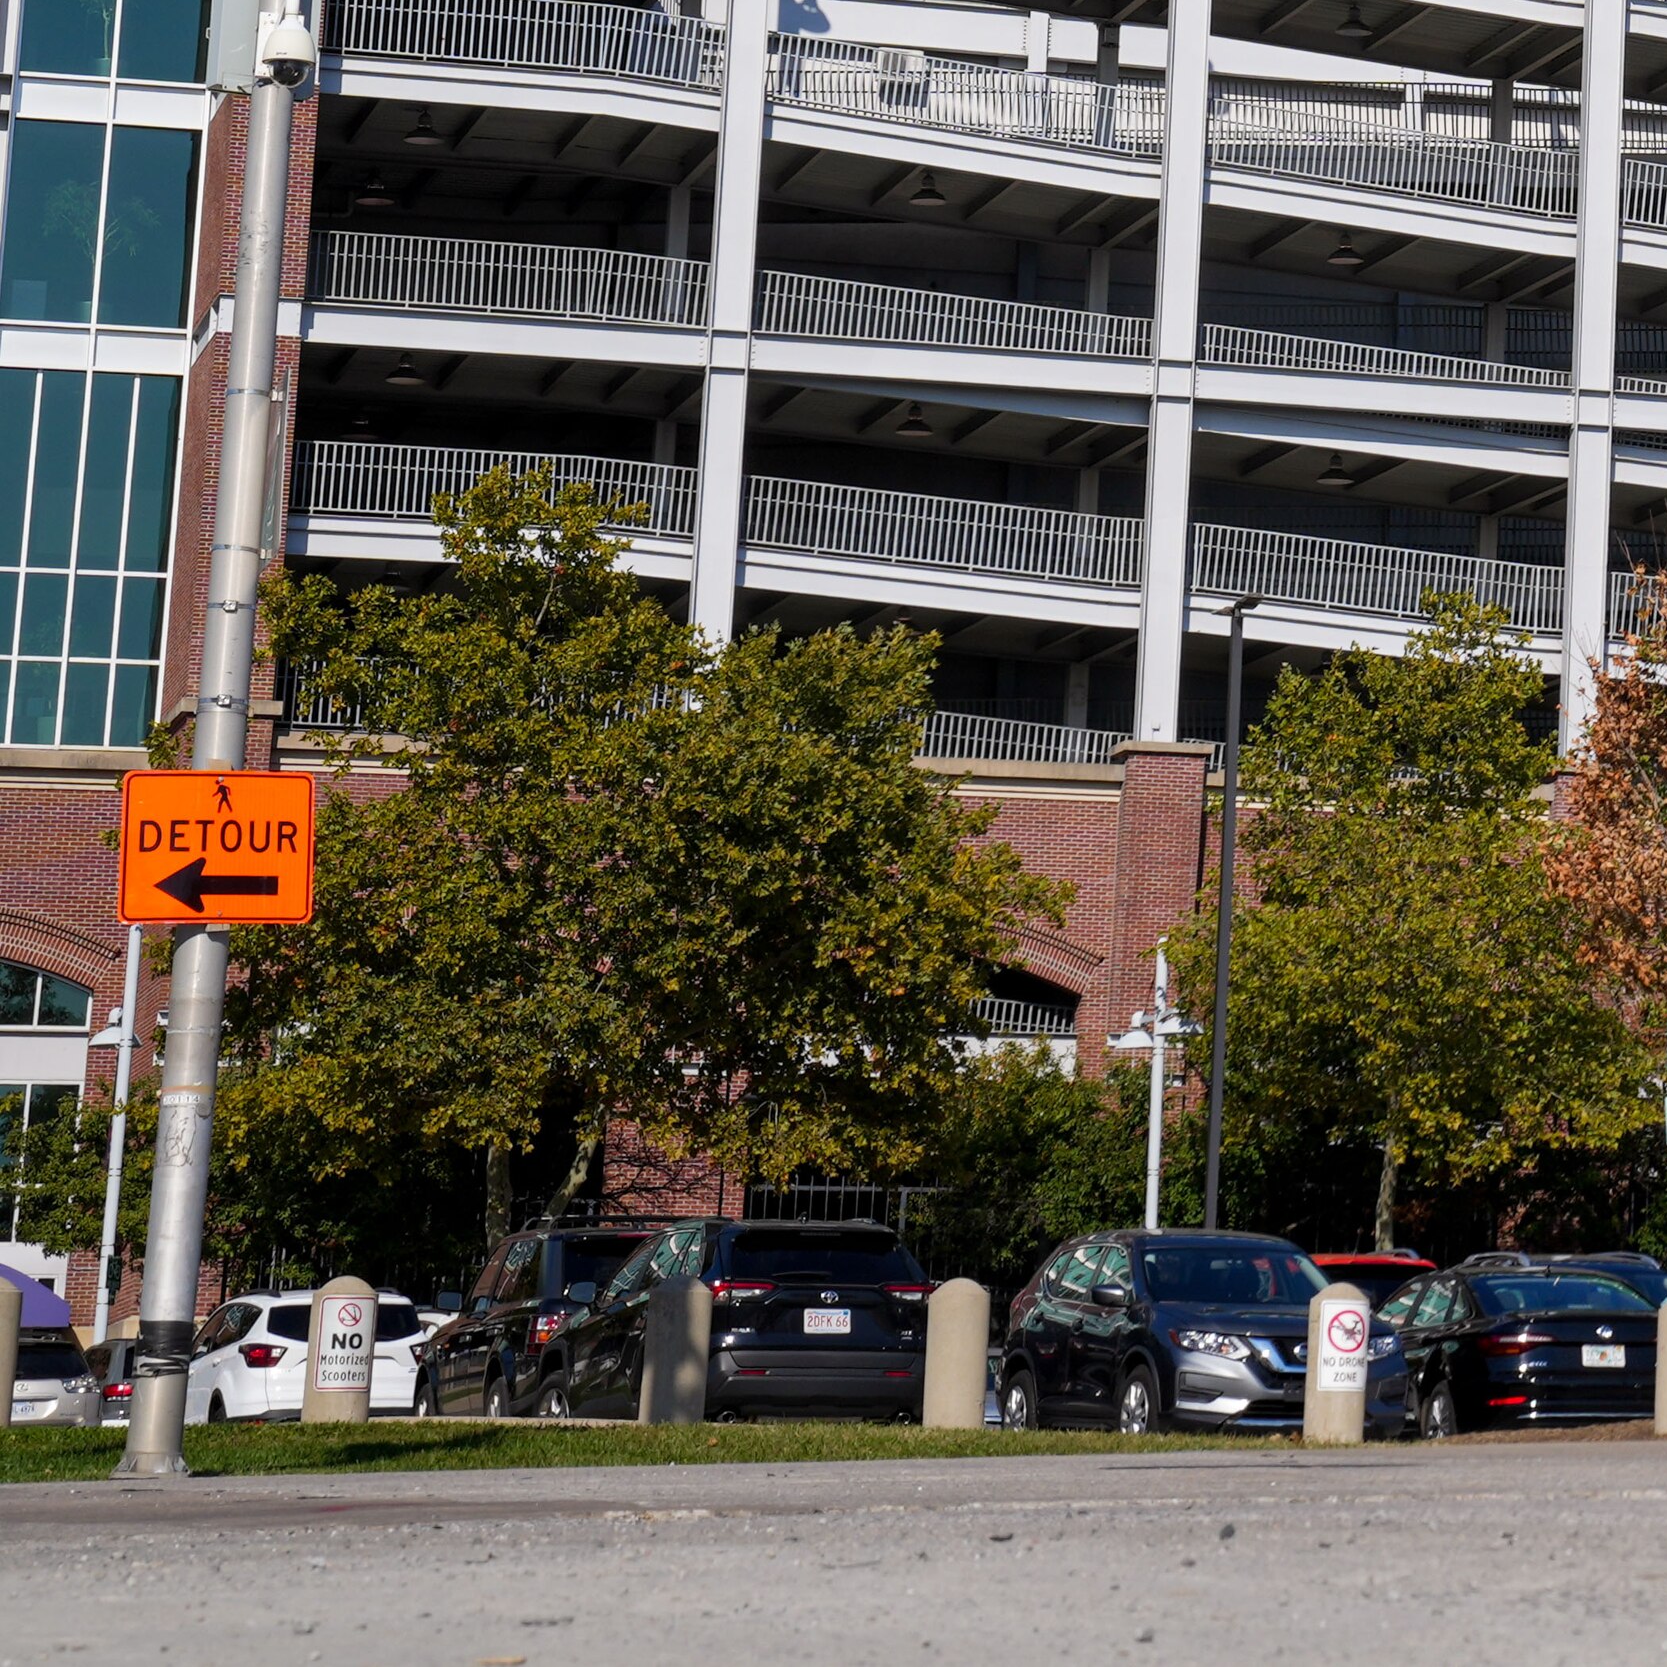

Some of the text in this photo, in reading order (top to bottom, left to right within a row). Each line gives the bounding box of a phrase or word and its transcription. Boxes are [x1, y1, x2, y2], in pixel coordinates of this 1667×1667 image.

[139, 820, 297, 853] DETOUR
[835, 1316, 848, 1327] 66
[331, 1333, 363, 1349] NO
[320, 1354, 368, 1366] Motorized
[1323, 1356, 1366, 1368] NO DRONE
[321, 1370, 365, 1381] Scooters
[1333, 1372, 1357, 1382] ZONE
